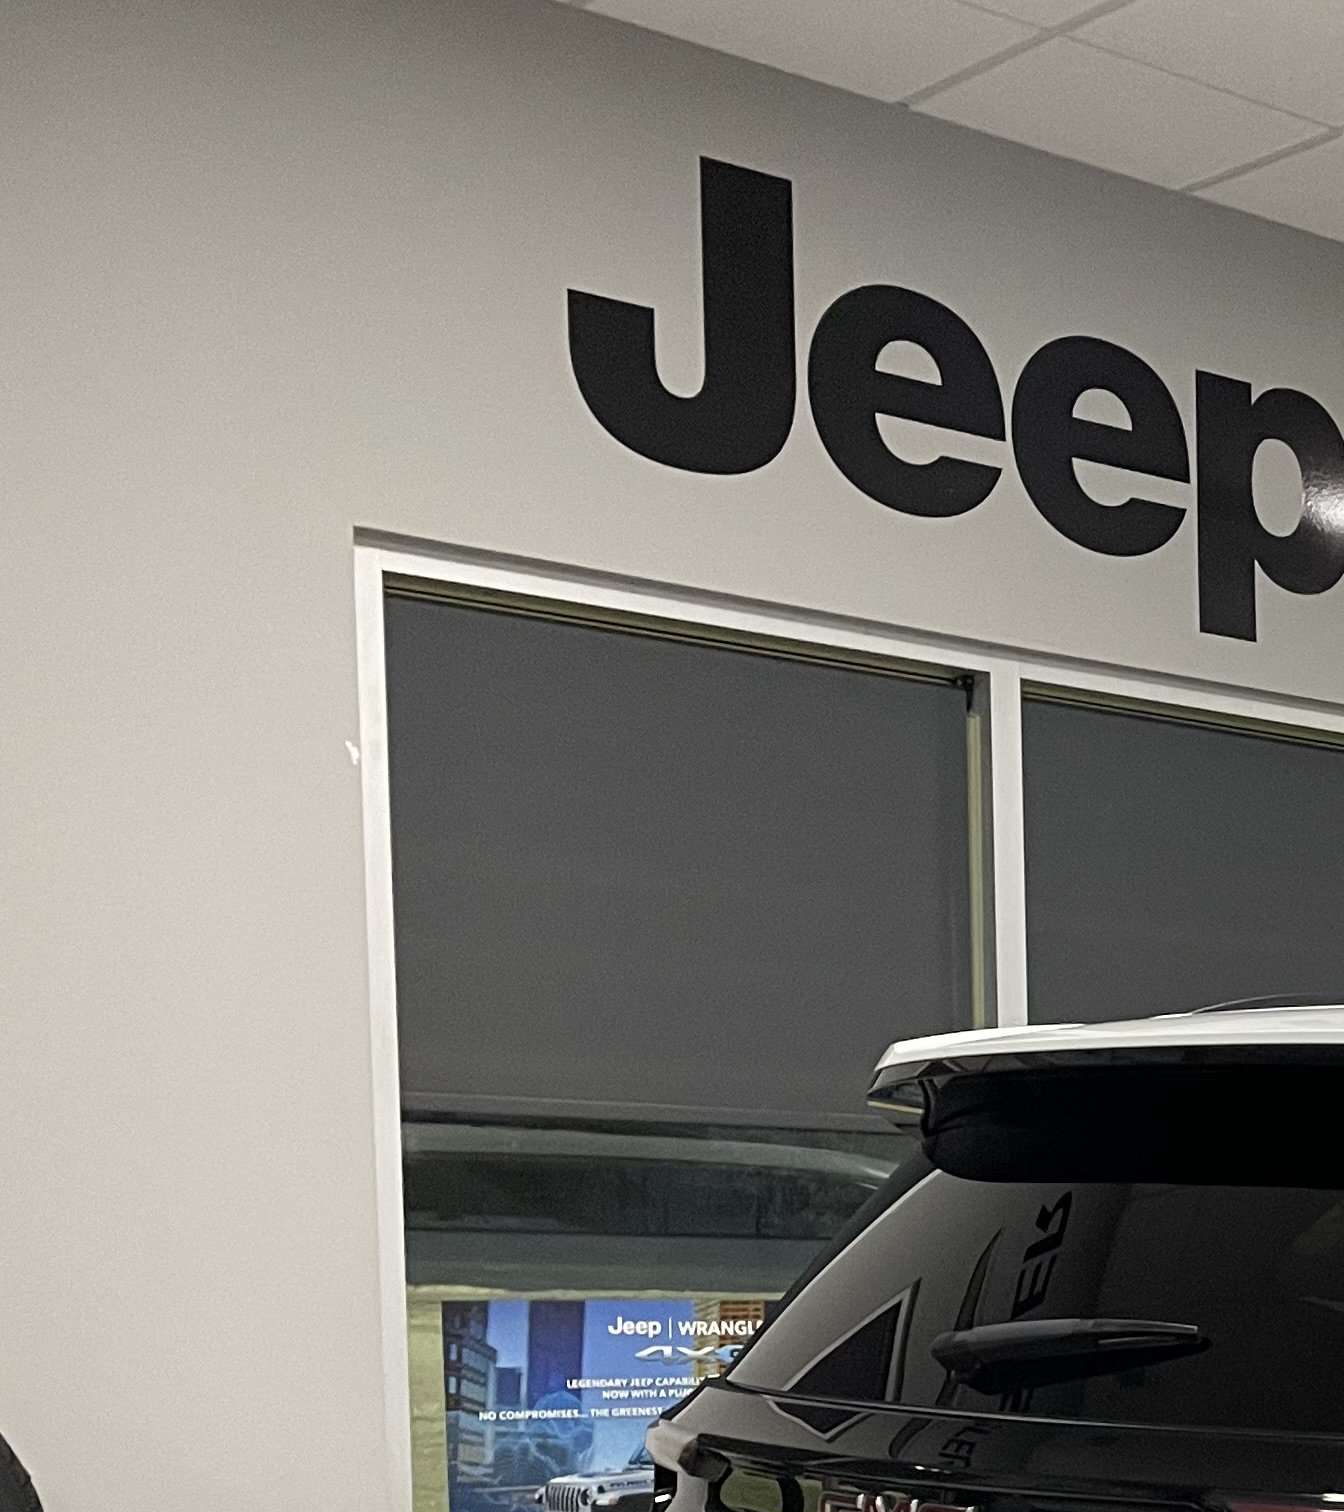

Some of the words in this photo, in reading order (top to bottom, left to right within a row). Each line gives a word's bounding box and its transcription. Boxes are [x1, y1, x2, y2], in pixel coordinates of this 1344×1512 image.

[608, 1316, 662, 1338] Jeep
[566, 1378, 627, 1390] LEGENDARY
[630, 1378, 655, 1388] JEEP
[602, 1390, 629, 1401] NOW
[631, 1389, 657, 1400] WITH
[659, 1389, 667, 1399] A
[479, 1410, 497, 1421] NO
[590, 1408, 609, 1418] THE
[611, 1406, 663, 1417] GREENEST
